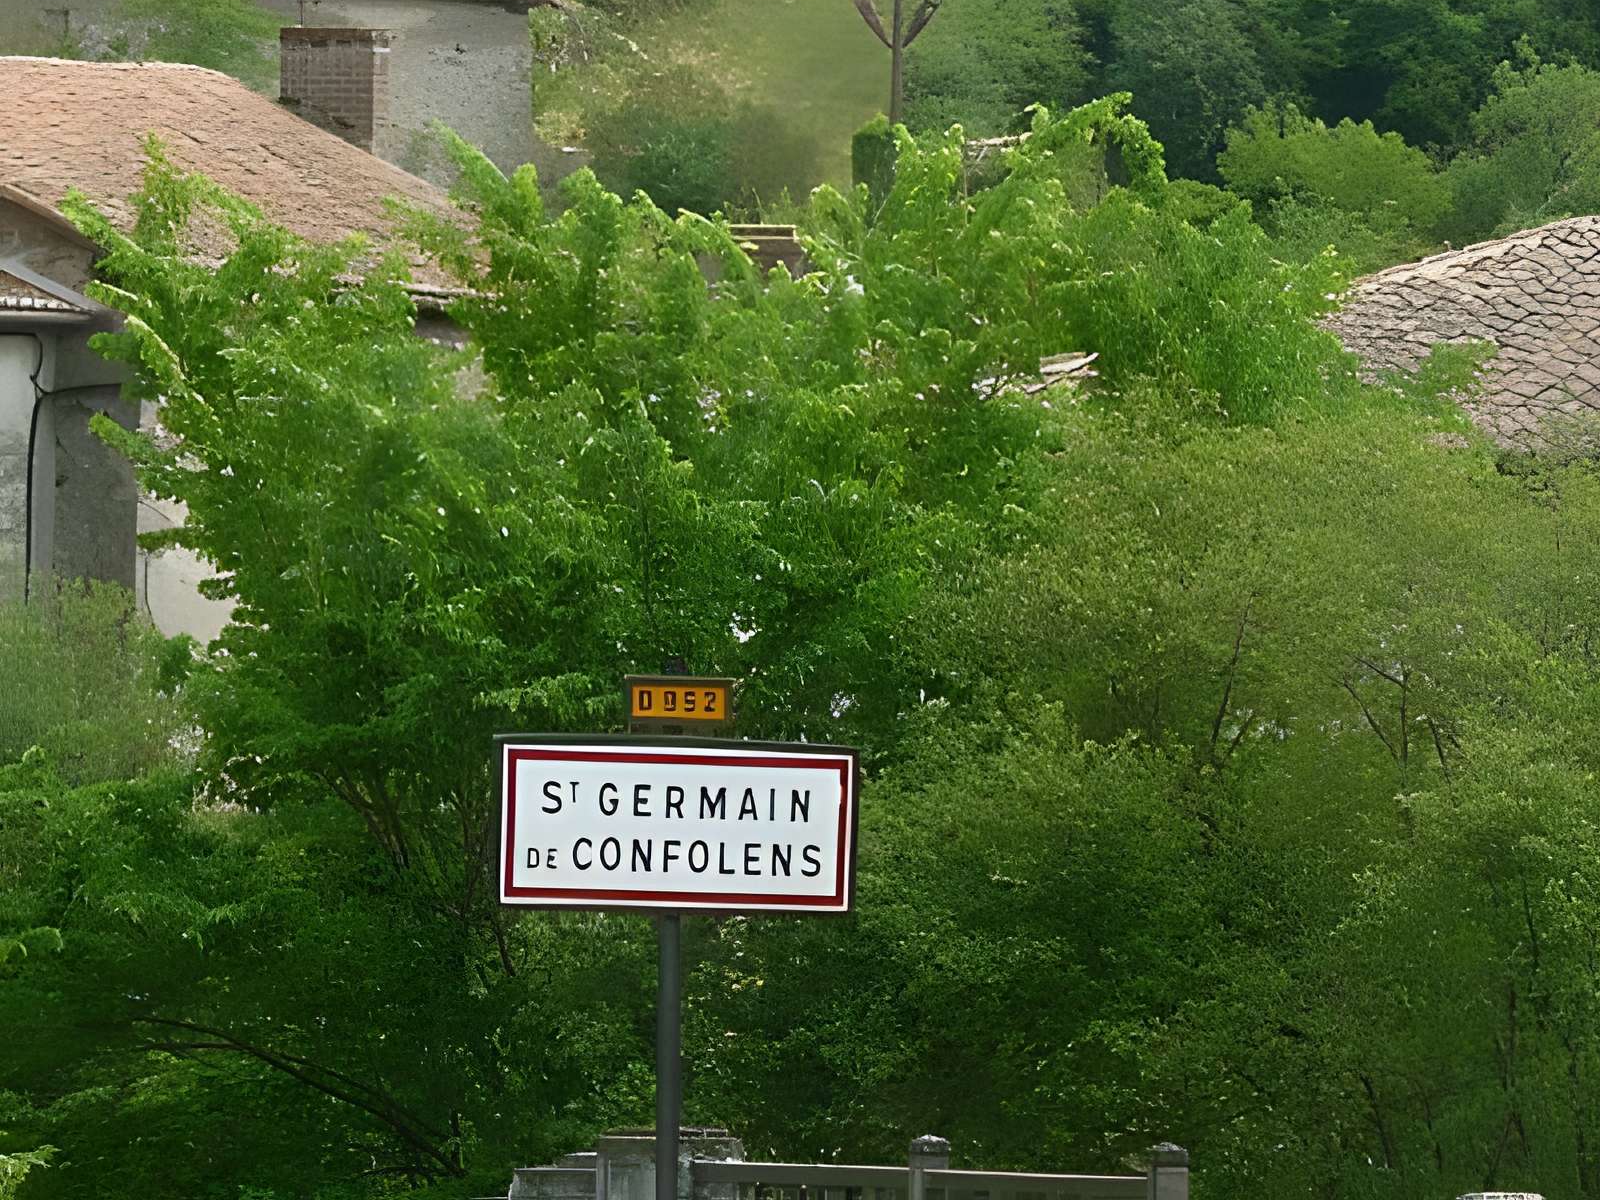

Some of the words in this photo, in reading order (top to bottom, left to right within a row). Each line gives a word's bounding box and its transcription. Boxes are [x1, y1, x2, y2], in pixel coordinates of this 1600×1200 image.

[598, 782, 811, 823] GERMAIN
[526, 847, 558, 870] DE
[572, 836, 821, 878] CONFOLENS
